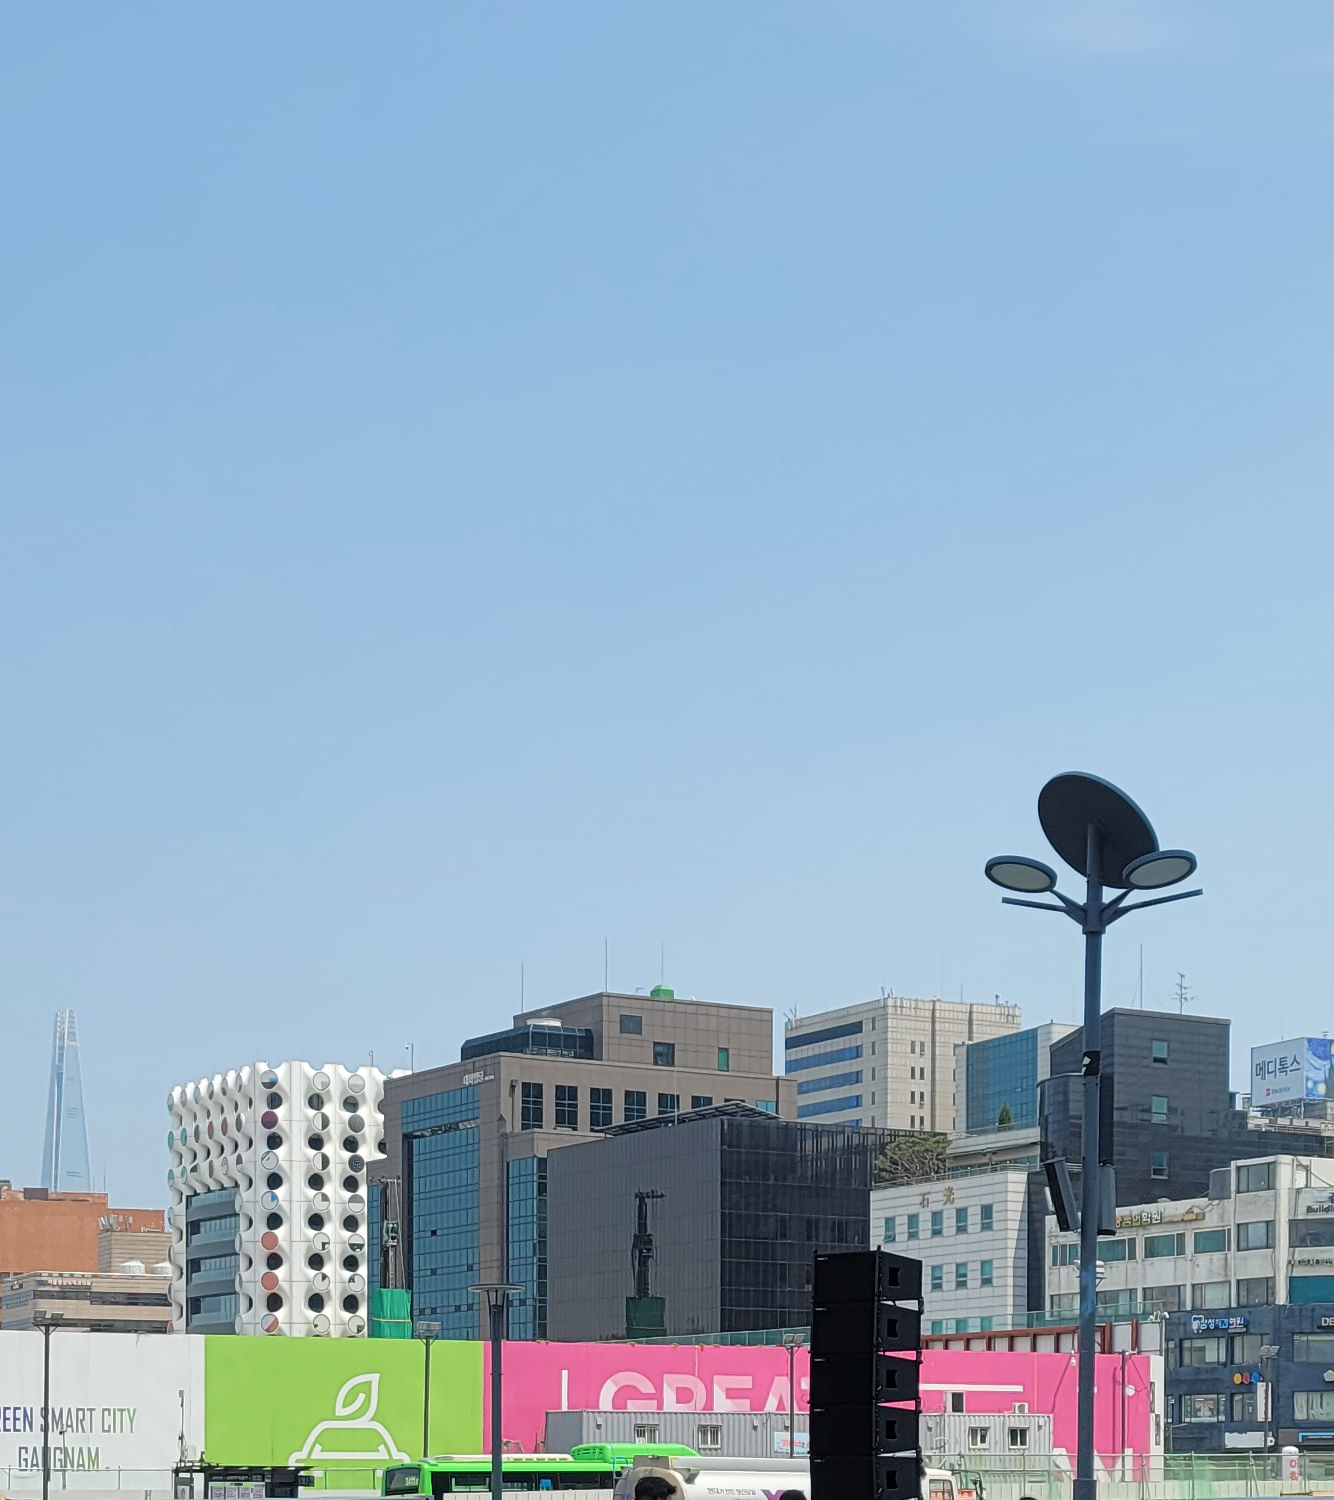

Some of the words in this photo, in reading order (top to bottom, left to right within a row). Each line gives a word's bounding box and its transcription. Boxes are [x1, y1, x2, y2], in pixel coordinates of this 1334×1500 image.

[1255, 1054, 1301, 1081] 메디톡스
[599, 1371, 809, 1412] GREA
[101, 1407, 137, 1433] CITY
